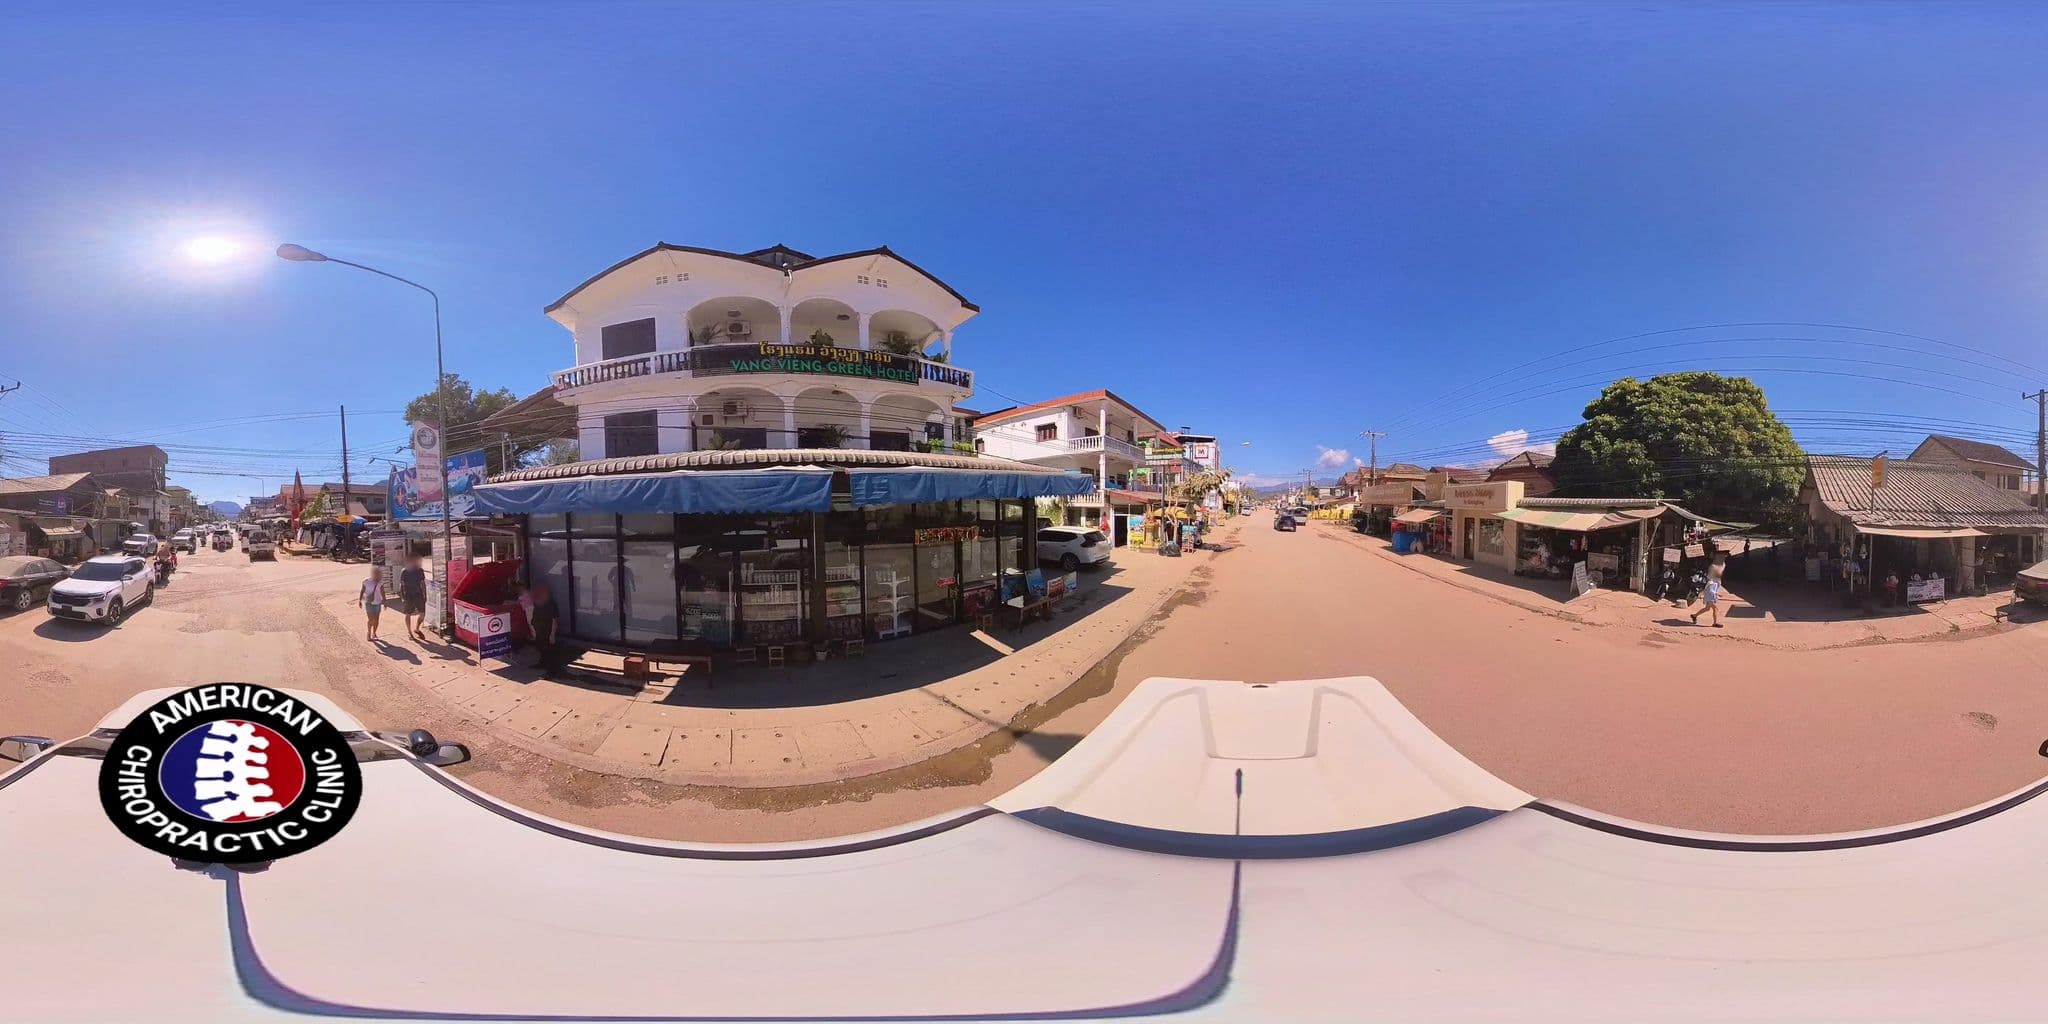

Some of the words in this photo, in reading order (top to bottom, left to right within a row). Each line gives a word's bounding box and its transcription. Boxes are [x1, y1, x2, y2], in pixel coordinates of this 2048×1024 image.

[731, 358, 772, 371] VANG
[777, 358, 822, 372] VIENG
[827, 361, 872, 376] GREEN
[876, 367, 919, 382] HOTEL
